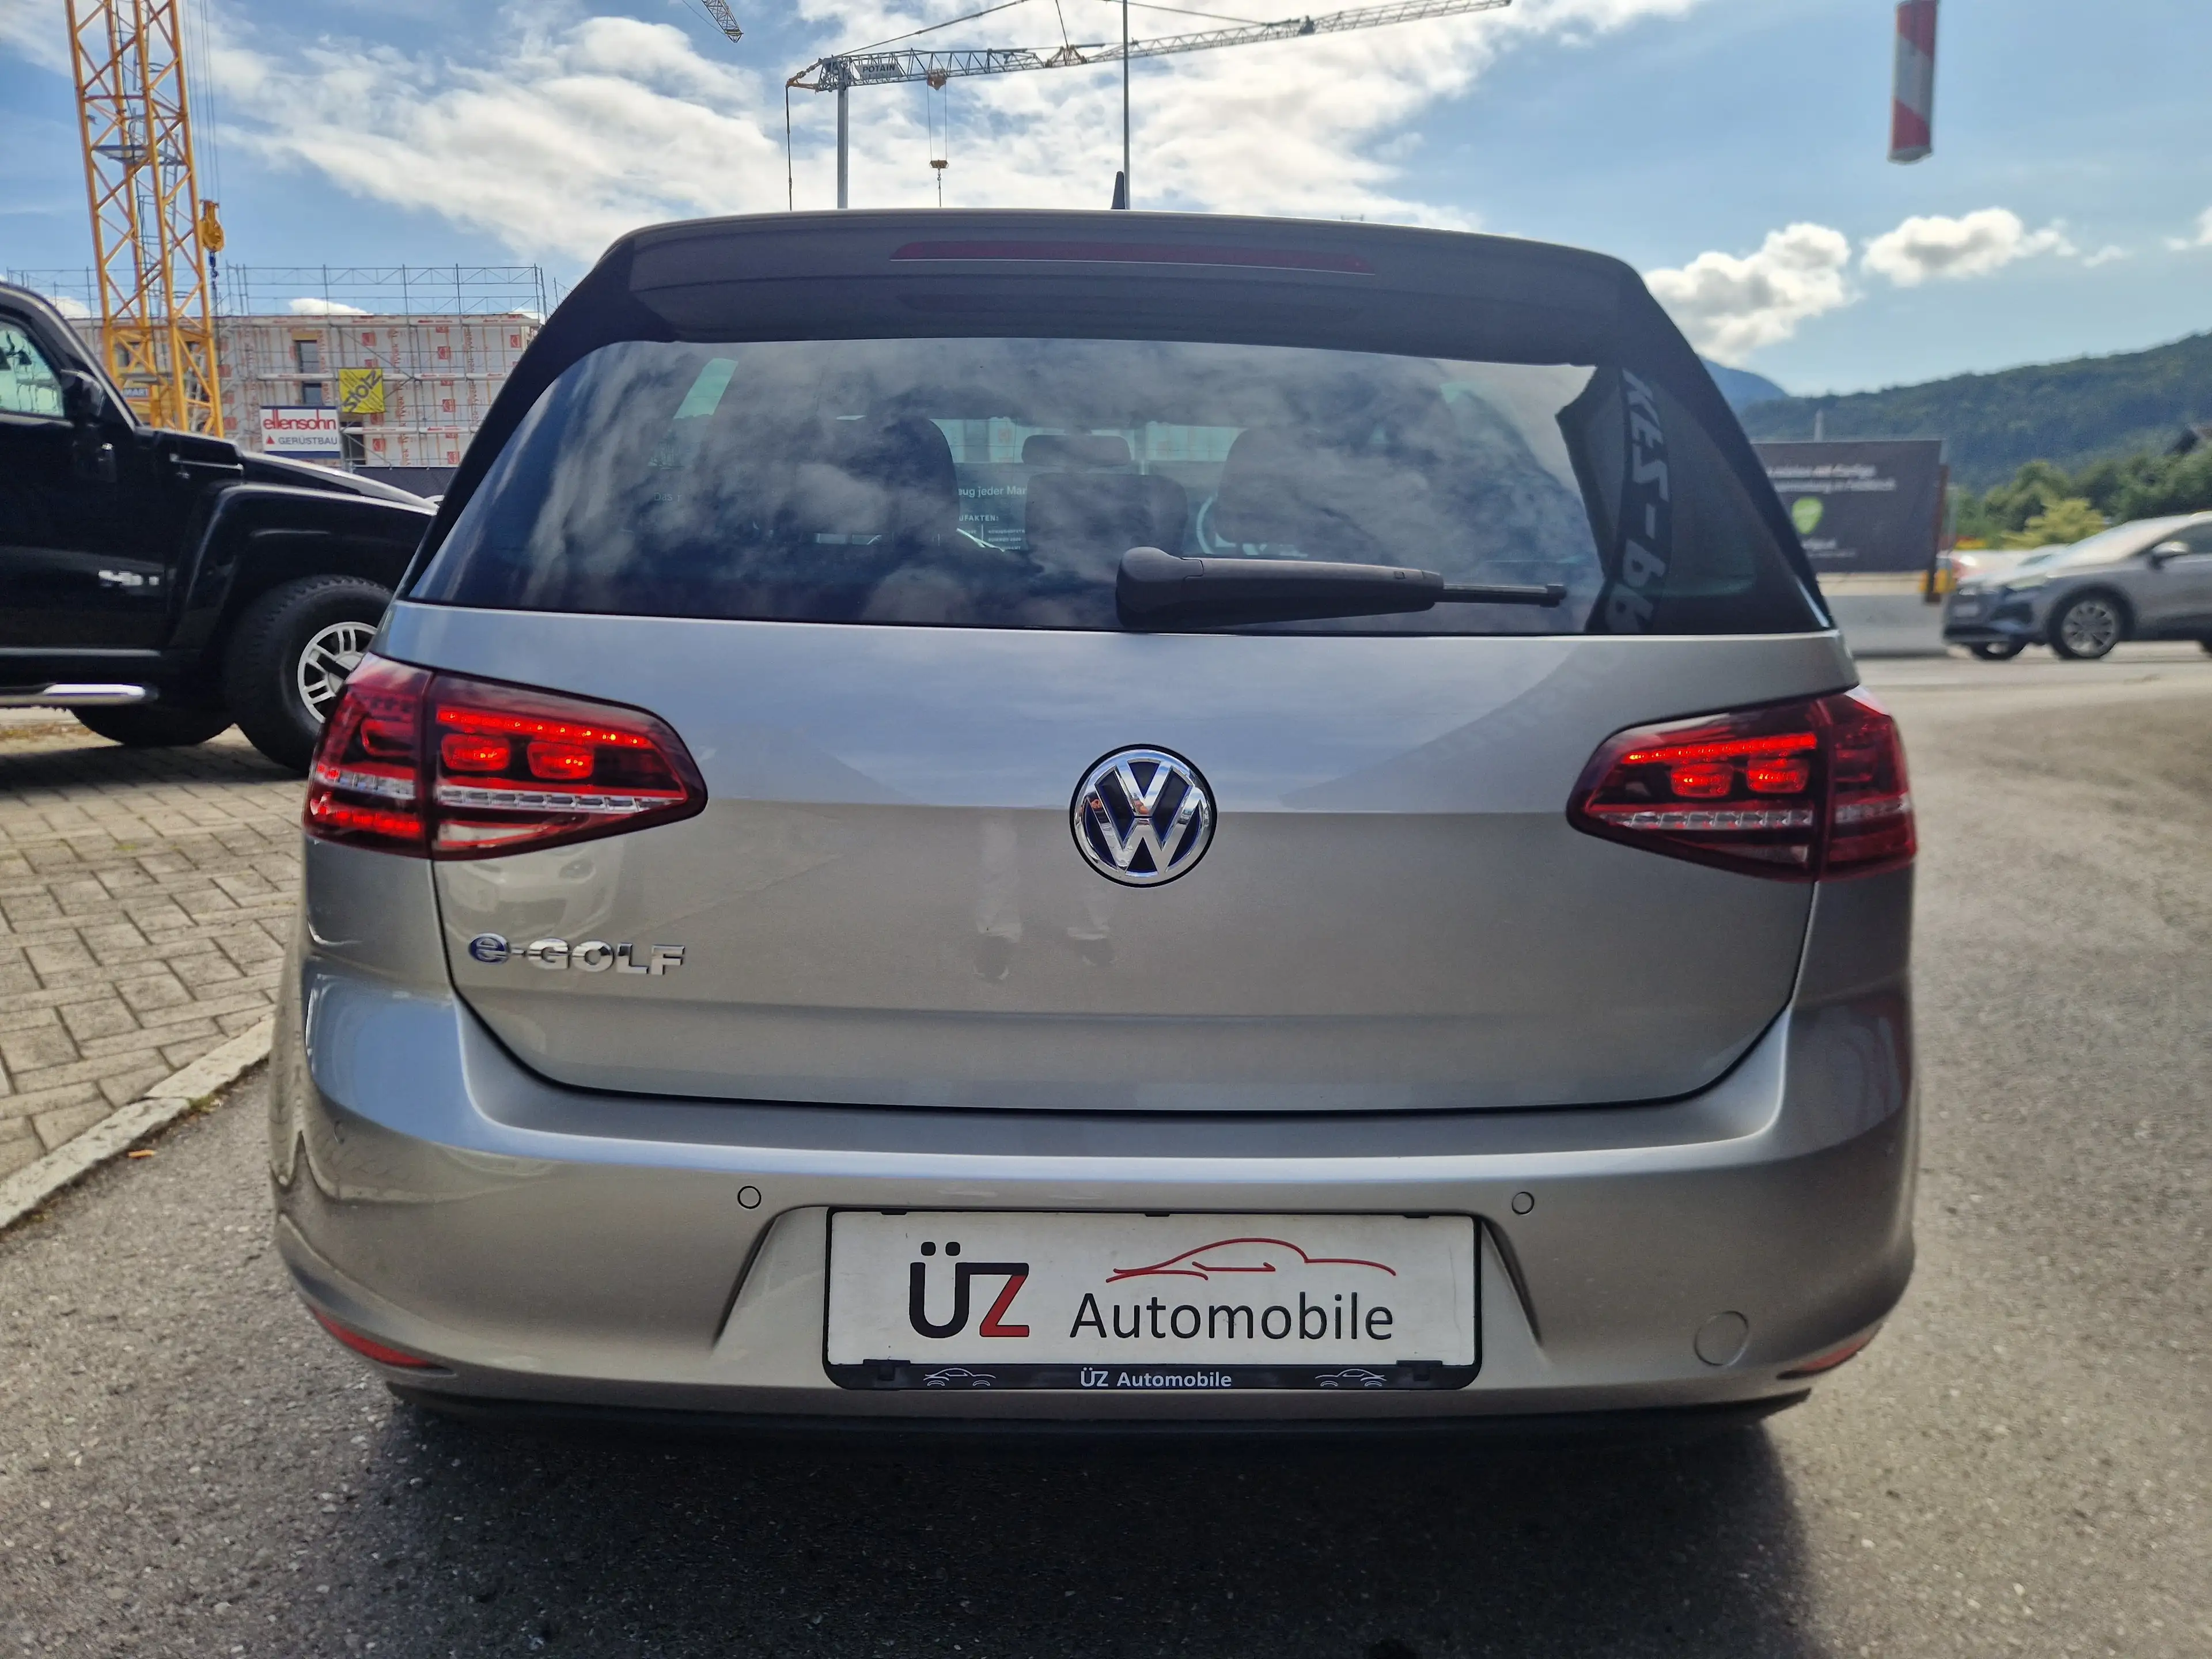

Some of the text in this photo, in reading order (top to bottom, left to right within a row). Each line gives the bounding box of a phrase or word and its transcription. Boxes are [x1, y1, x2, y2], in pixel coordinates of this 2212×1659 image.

[862, 65, 895, 73] POTAIN
[342, 370, 381, 412] stolz
[263, 409, 336, 430] ellensohn
[278, 434, 338, 445] GERÜSTBAU
[978, 486, 1003, 498] jeder
[1074, 749, 1213, 885] VW
[469, 932, 685, 975] e-GOLF
[909, 1241, 1393, 1340] ÜZ Automobile
[1081, 1367, 1232, 1387] ÜZ Automobile
